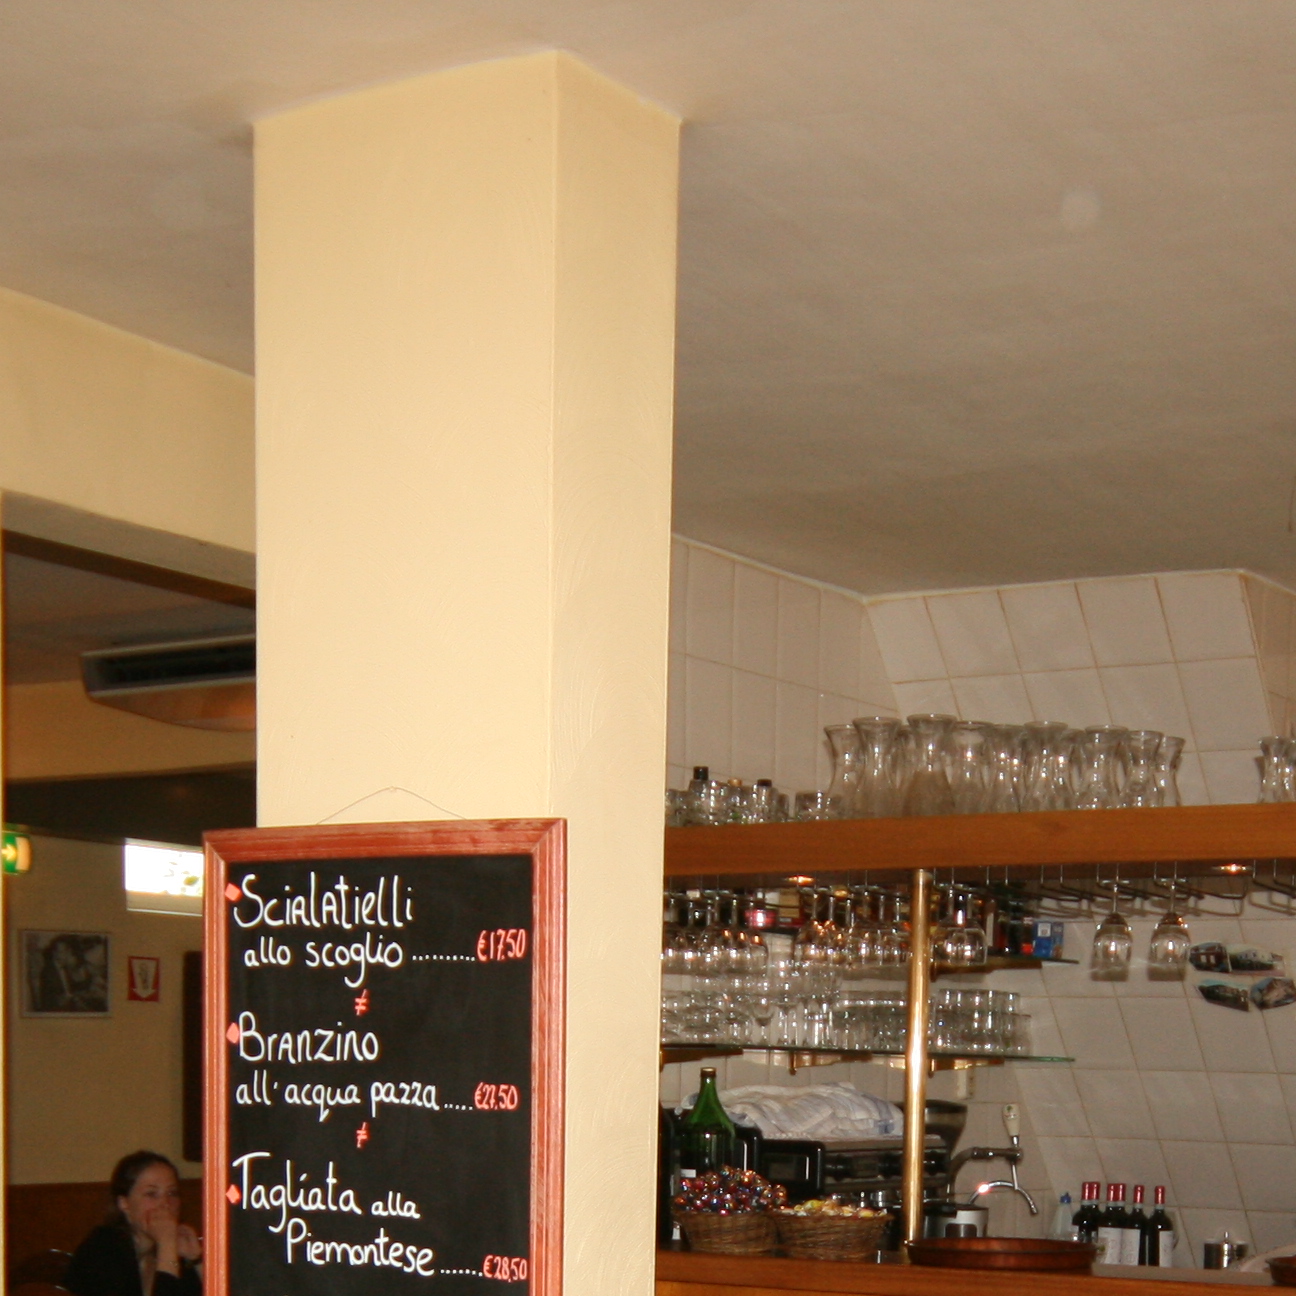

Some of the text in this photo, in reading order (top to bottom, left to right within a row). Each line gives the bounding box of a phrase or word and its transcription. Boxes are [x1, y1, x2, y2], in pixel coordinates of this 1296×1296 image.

[244, 936, 292, 967] allo
[306, 931, 403, 988] scoglio
[370, 1081, 440, 1118] pazza
[232, 1151, 421, 1233] Tagliata alla
[286, 1217, 435, 1277] Piemontese
